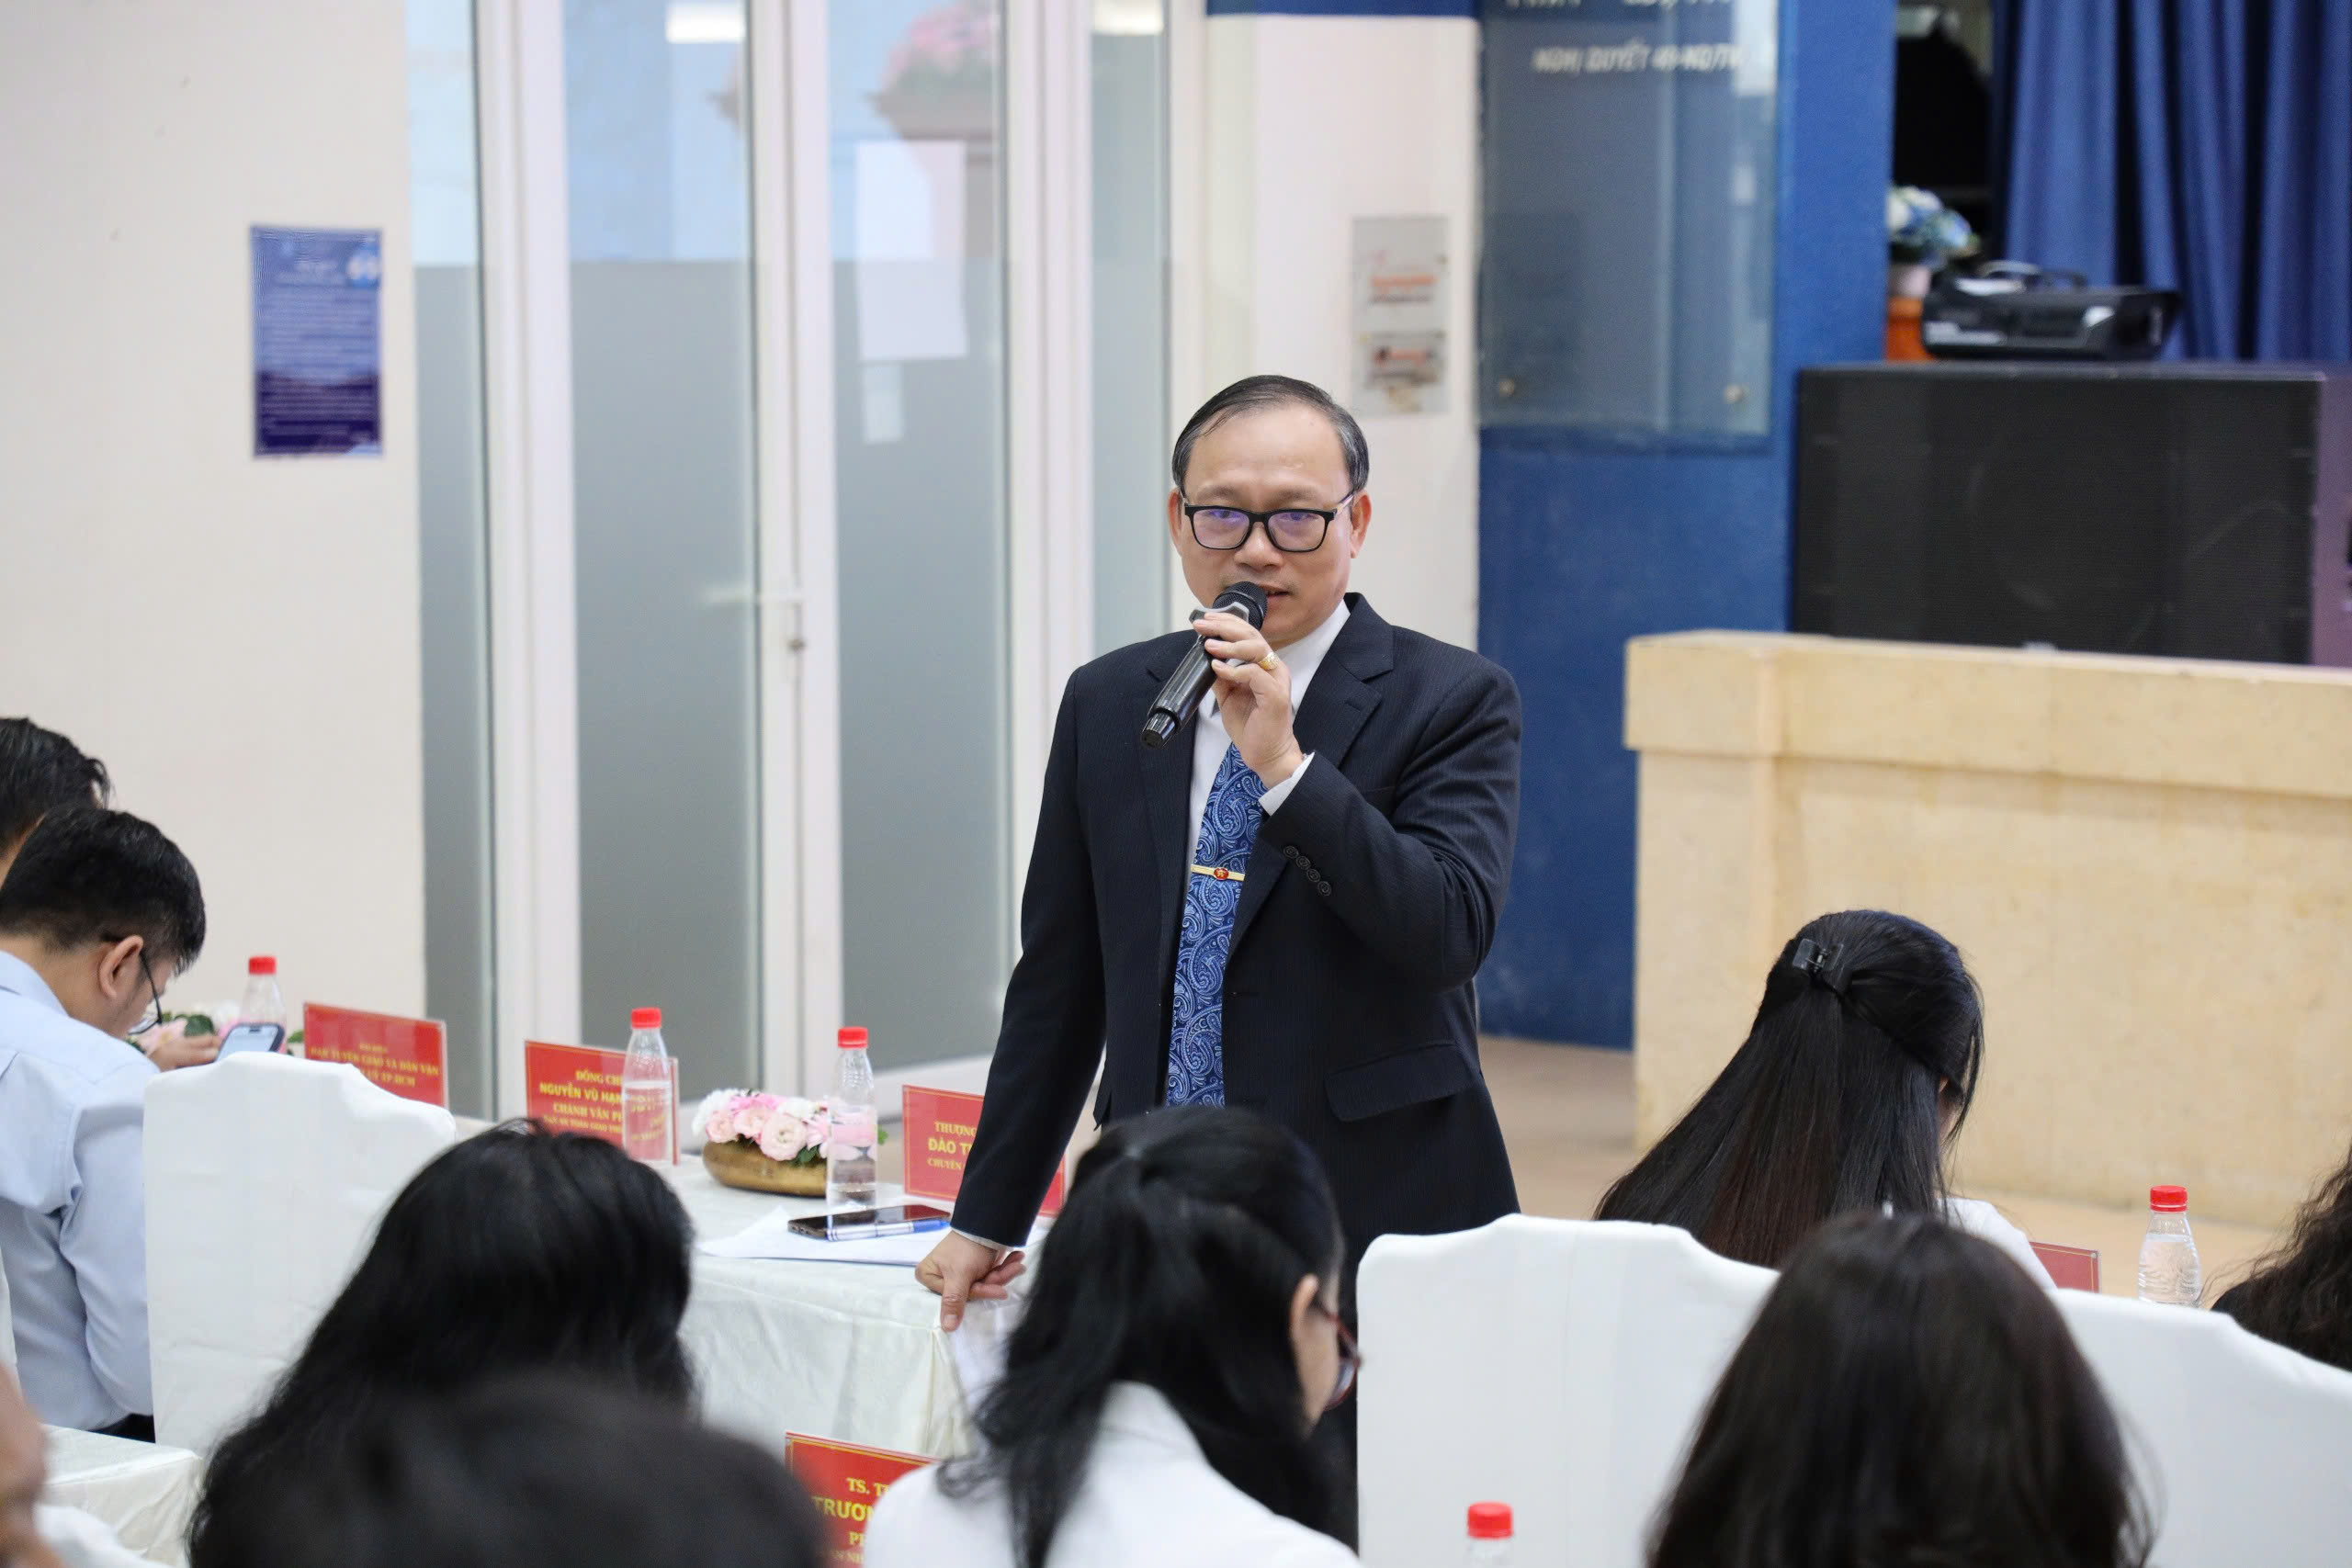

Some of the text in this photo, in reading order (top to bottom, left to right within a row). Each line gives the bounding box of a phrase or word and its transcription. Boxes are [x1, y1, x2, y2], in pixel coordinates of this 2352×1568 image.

[539, 1081, 581, 1098] NGUYỄN
[601, 1090, 625, 1107] HẠN
[846, 1477, 870, 1495] TS.
